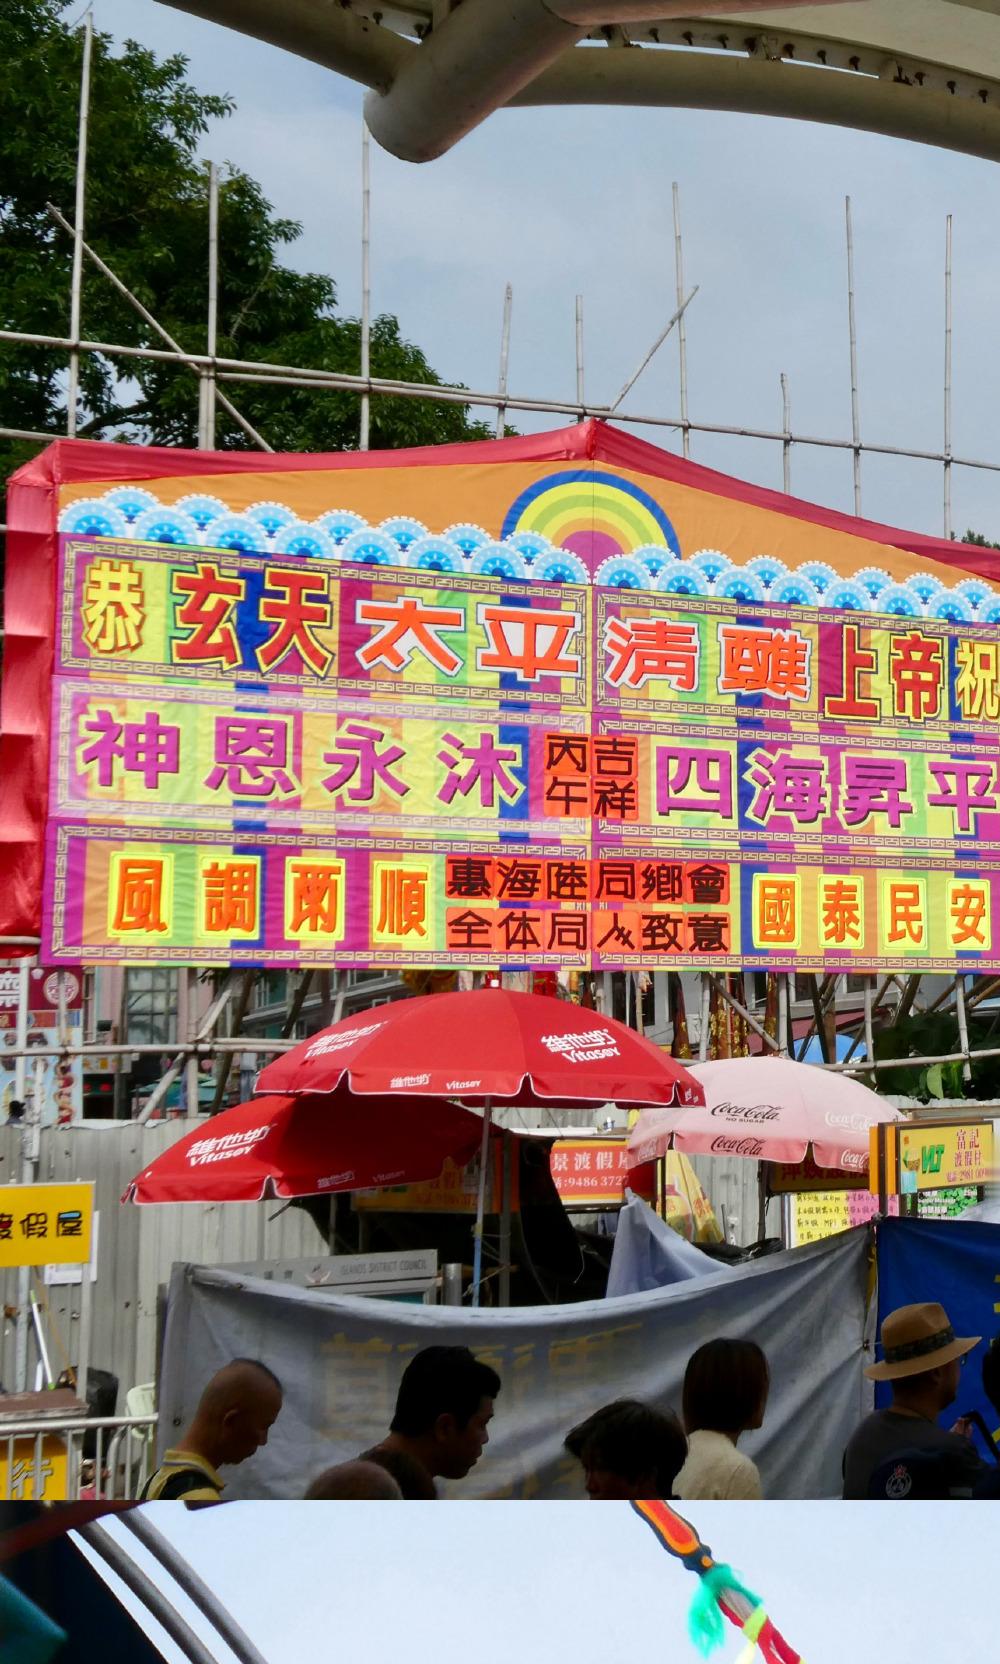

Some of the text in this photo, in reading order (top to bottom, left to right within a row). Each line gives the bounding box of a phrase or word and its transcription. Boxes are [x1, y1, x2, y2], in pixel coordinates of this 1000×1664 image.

[79, 708, 524, 808] 神恩永沐
[659, 744, 1000, 836] 四海昇平
[111, 857, 431, 938] 風調雨順
[755, 878, 989, 947] 國泰民安
[446, 1079, 481, 1091] Vitasoy
[562, 1047, 621, 1064] Vitasoy
[189, 1145, 255, 1168] Vitasoy
